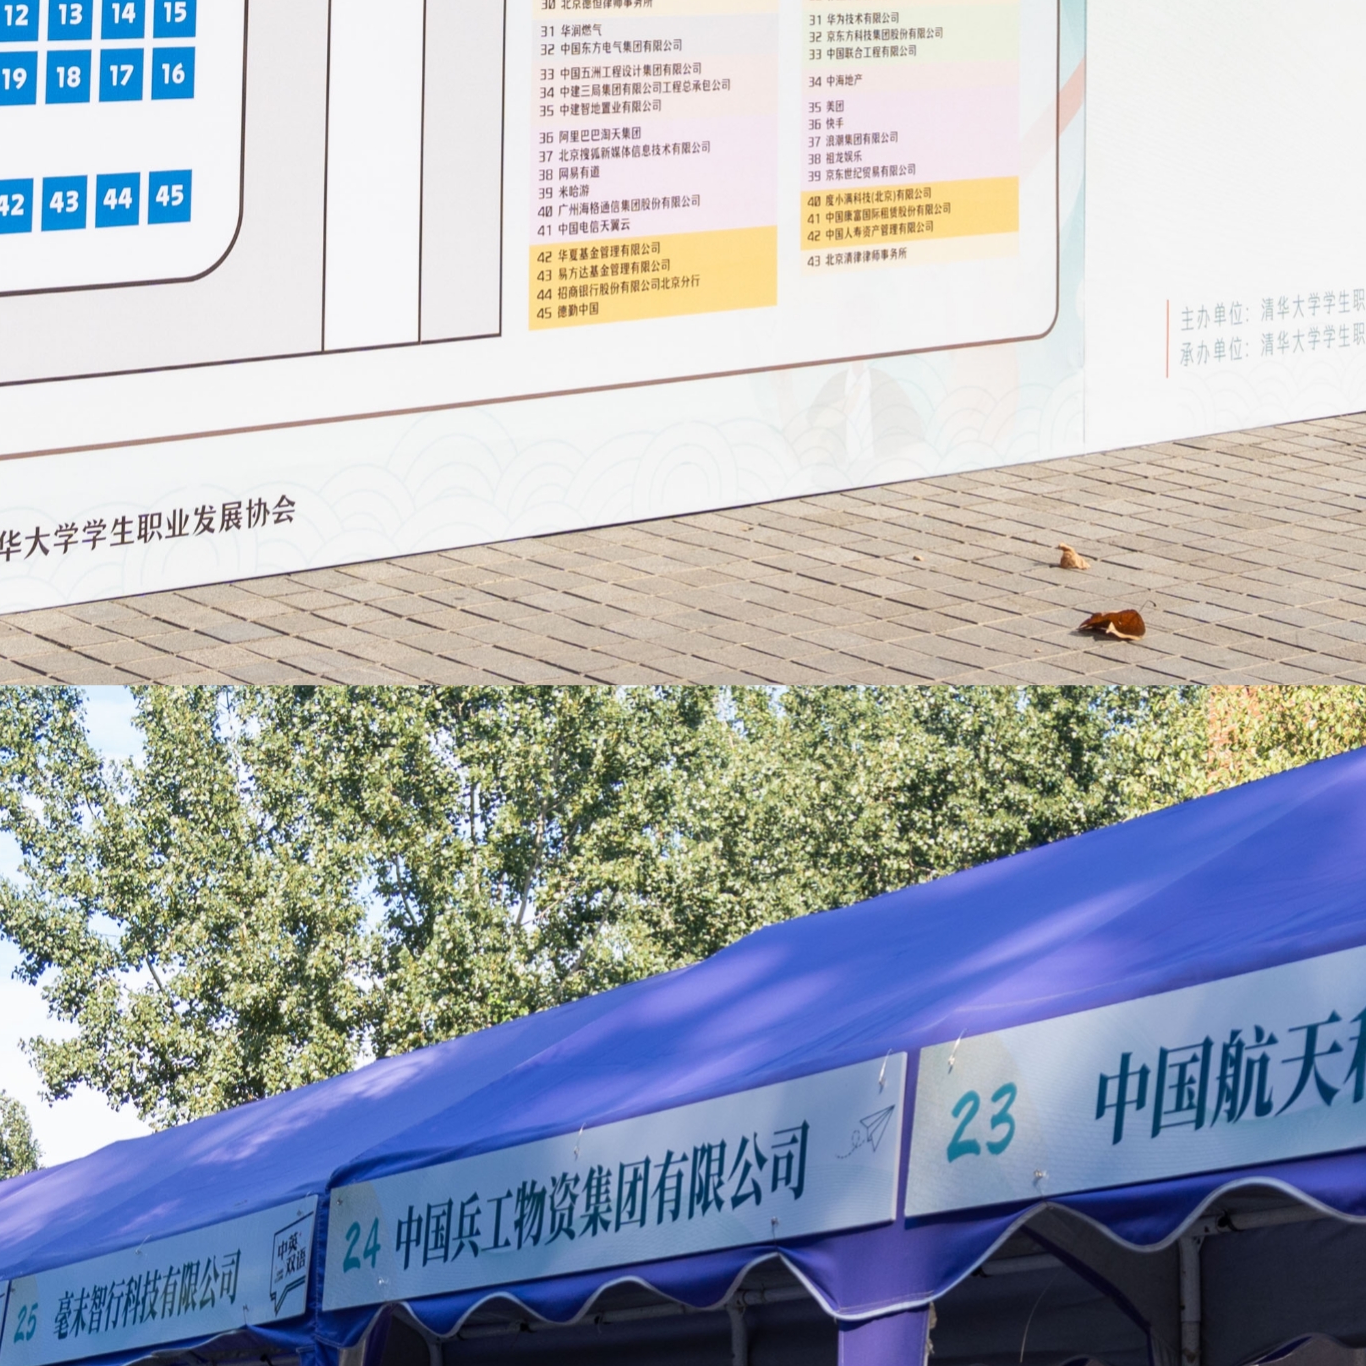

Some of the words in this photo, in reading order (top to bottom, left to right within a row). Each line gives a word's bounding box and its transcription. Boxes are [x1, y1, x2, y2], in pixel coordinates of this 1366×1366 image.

[4, 4, 29, 27] 12
[58, 2, 83, 25] 13
[111, 2, 136, 24] 14
[163, 1, 187, 23] 15
[809, 15, 821, 25] 31
[827, 12, 899, 25] 华为技术有限公司
[541, 44, 554, 55] 32
[561, 39, 682, 55] 中国东方电气集团有限公司
[809, 119, 821, 129] 36
[826, 117, 844, 130] 快手
[539, 169, 553, 181] 38
[559, 166, 600, 180] 网易有道
[538, 225, 551, 236] 41
[558, 218, 630, 236] 中国电信天翼云
[807, 256, 820, 267] 43
[536, 307, 551, 319] 45
[558, 302, 599, 319] 德勤中国
[948, 1082, 1017, 1165] 23
[343, 1217, 381, 1273] 24
[395, 1120, 809, 1270] 中国兵工物资集团有限公司
[13, 1303, 38, 1343] 25
[53, 1248, 242, 1341] 毫末智行科技有限公司
